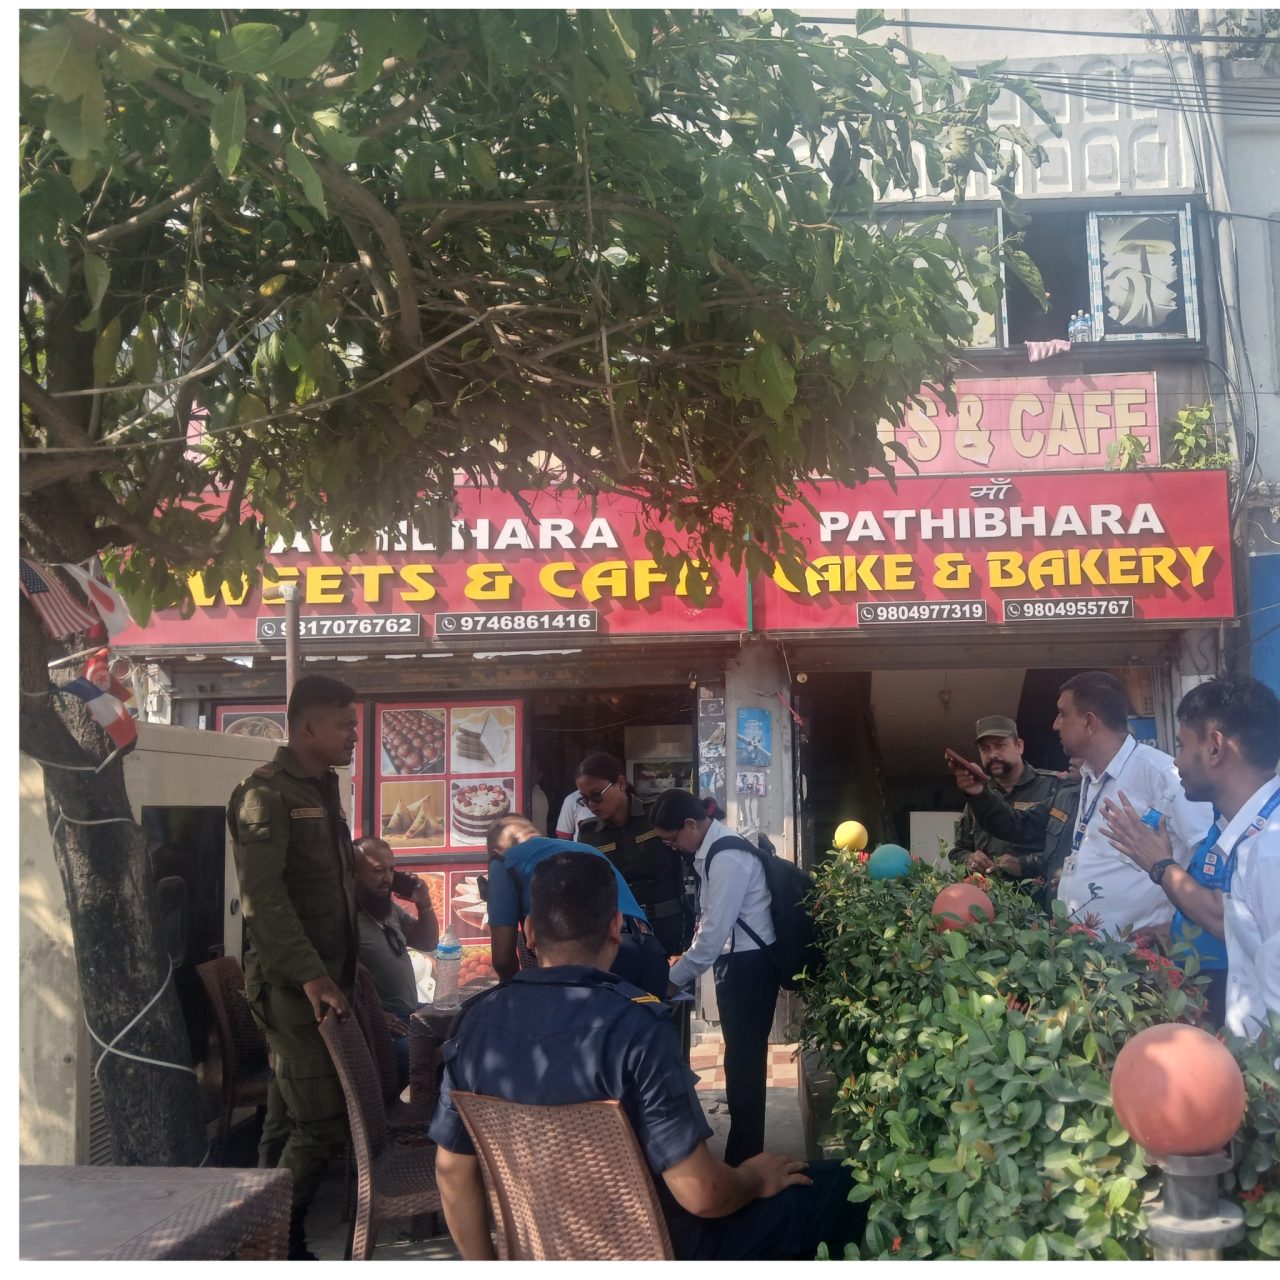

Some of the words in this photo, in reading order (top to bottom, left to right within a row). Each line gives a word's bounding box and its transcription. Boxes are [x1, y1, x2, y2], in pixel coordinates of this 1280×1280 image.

[1009, 388, 1151, 458] CAFE
[969, 478, 1012, 500] माँ
[820, 503, 1165, 542] PATHIBHARA
[932, 552, 972, 589] &
[986, 545, 1215, 590] BAKERY
[170, 564, 436, 607] WEETS
[464, 563, 513, 600] &
[461, 613, 590, 631] 9746861416
[877, 602, 983, 621] 9804977319
[1023, 599, 1130, 618] 9804955767
